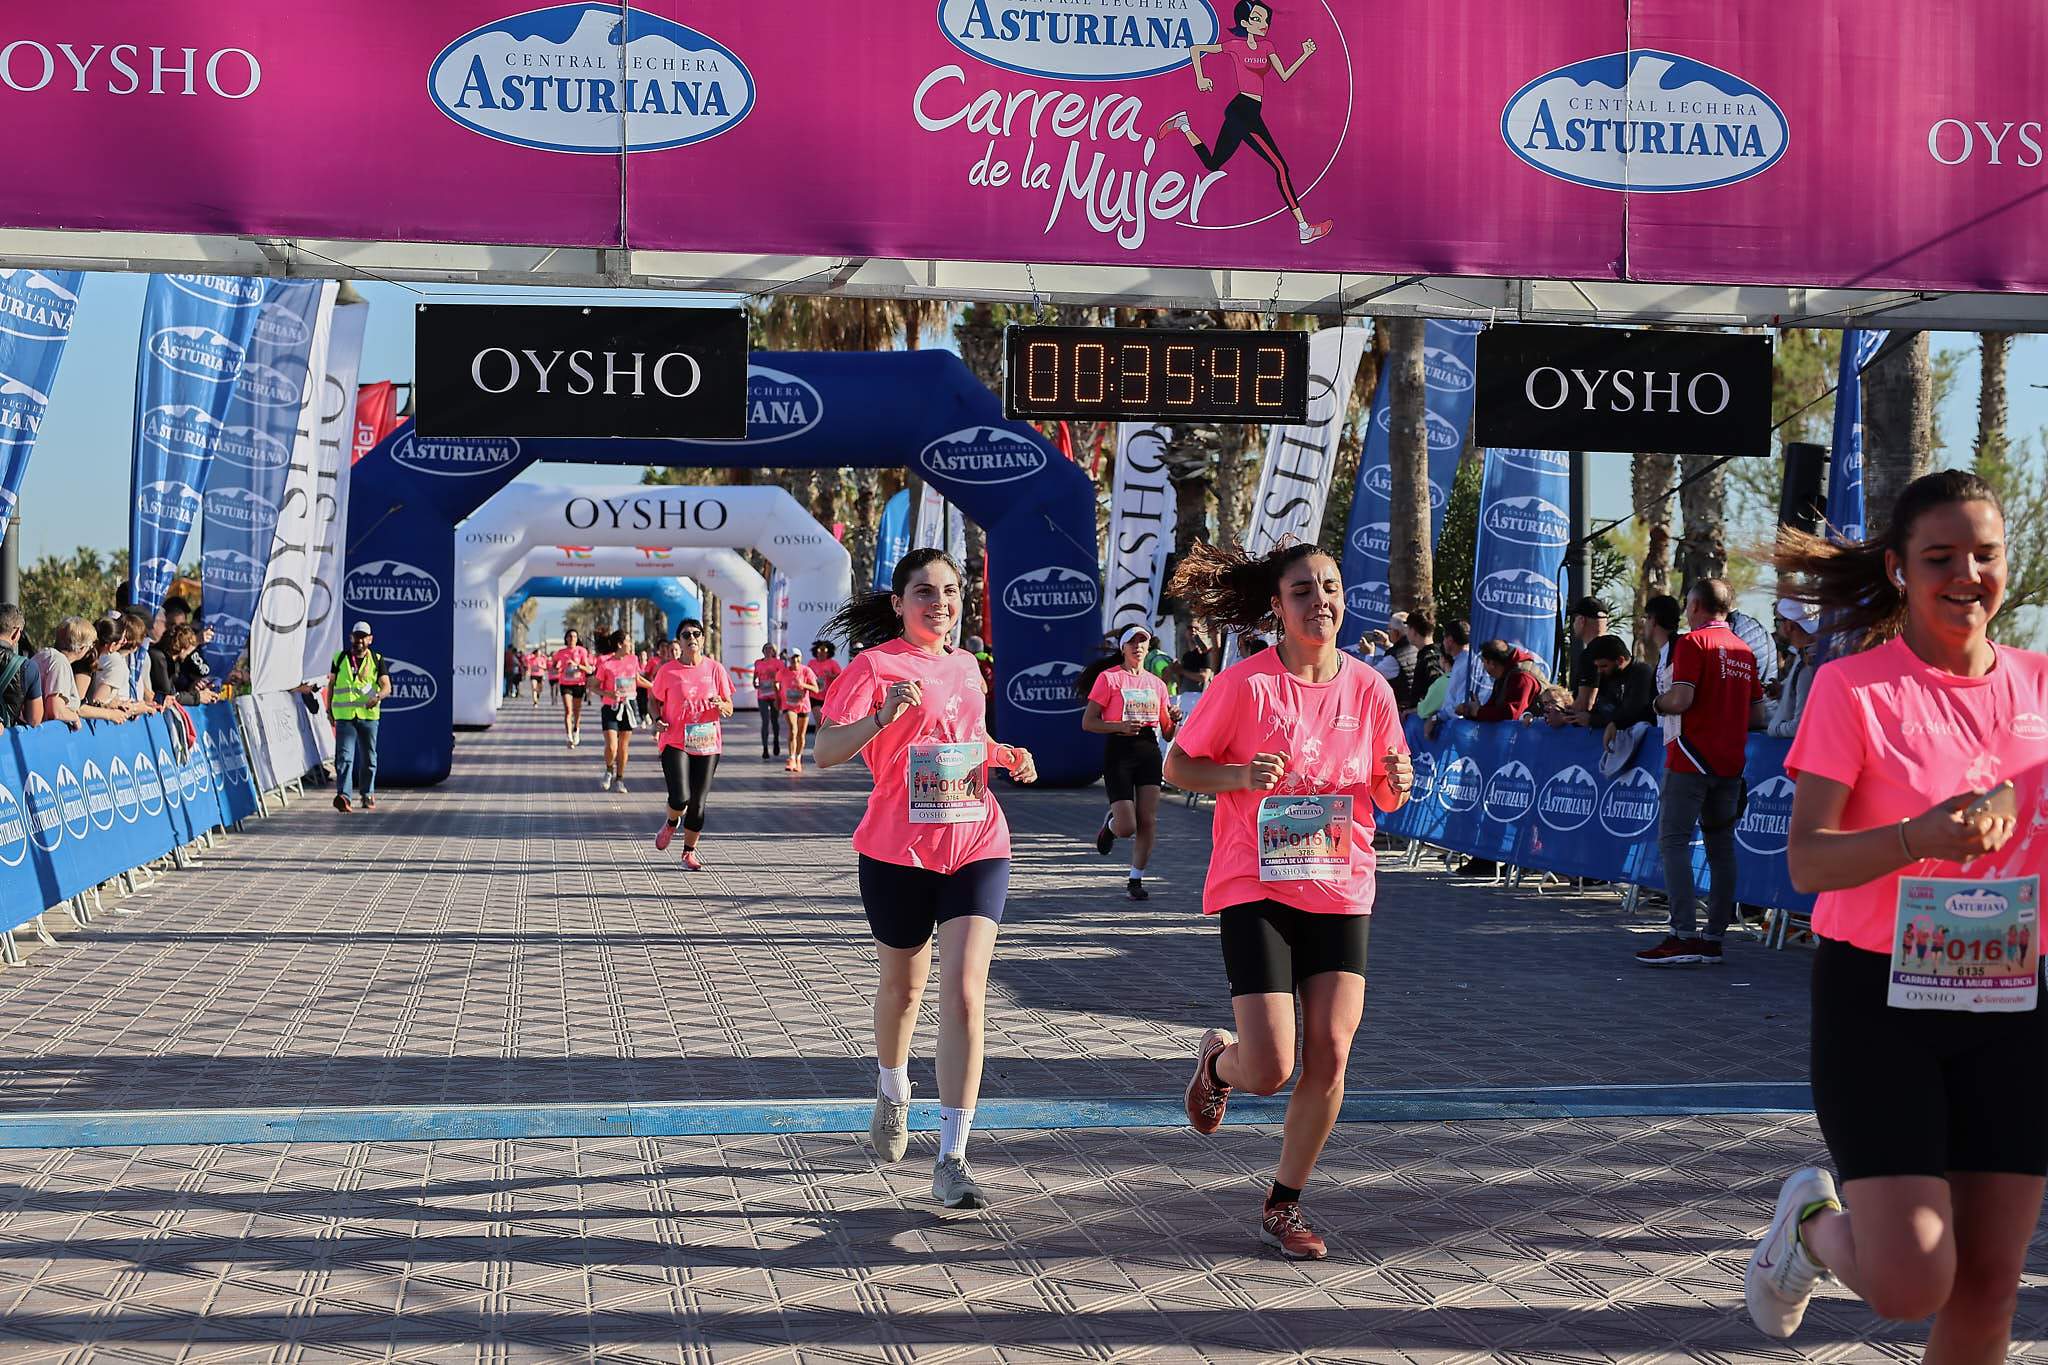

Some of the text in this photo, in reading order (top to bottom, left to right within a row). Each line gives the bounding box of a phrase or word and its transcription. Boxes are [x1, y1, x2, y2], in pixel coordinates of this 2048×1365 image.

[959, 0, 1194, 49] ASTURIANA
[0, 40, 262, 99] OYSHO
[505, 53, 607, 69] CENTRAL
[454, 54, 731, 117] ASTURIANA
[913, 64, 1143, 143] Carrera
[1569, 97, 1758, 117] CENTRAL LECHERA
[1524, 98, 1767, 158] ASTURIANA
[1928, 119, 2043, 168] OYS
[968, 137, 1228, 250] de la Mujer
[171, 274, 260, 301] STURIANA
[157, 336, 243, 374] ASTURIANA
[471, 346, 702, 399] OYSHO
[1028, 342, 1286, 406] 00:35:42
[1525, 366, 1731, 416] OYSHO
[398, 438, 510, 461] ASTURIANA
[932, 448, 1040, 470] ASTURIANA
[204, 496, 274, 525] ASTURIANA
[565, 497, 728, 531] OYSHO
[465, 532, 516, 545] OYSHO
[1489, 509, 1568, 541] ASTURIANA
[774, 533, 823, 546] OYSHO
[344, 580, 434, 602] ASTURIANA
[1010, 587, 1093, 607] ASTURIANA
[1487, 781, 1530, 808] ASTURIANA
[1541, 788, 1592, 815] ASTURIANA
[1603, 792, 1654, 820] ASTURIANA
[919, 811, 947, 819] OYSHO
[1288, 807, 1322, 817] ASTURIANA
[1288, 832, 1323, 847] 016
[1270, 867, 1301, 876] OYSHO
[1950, 897, 2005, 912] ASTURIANA
[1947, 939, 2003, 961] 016
[1900, 974, 1938, 986] CARRERA
[1940, 978, 1951, 987] DE
[1953, 978, 1964, 987] LA
[1966, 978, 1993, 988] MUJER
[2000, 977, 2033, 987] VALENCIA
[1957, 966, 1985, 976] 6135
[1906, 991, 1956, 1002] OYSHO
